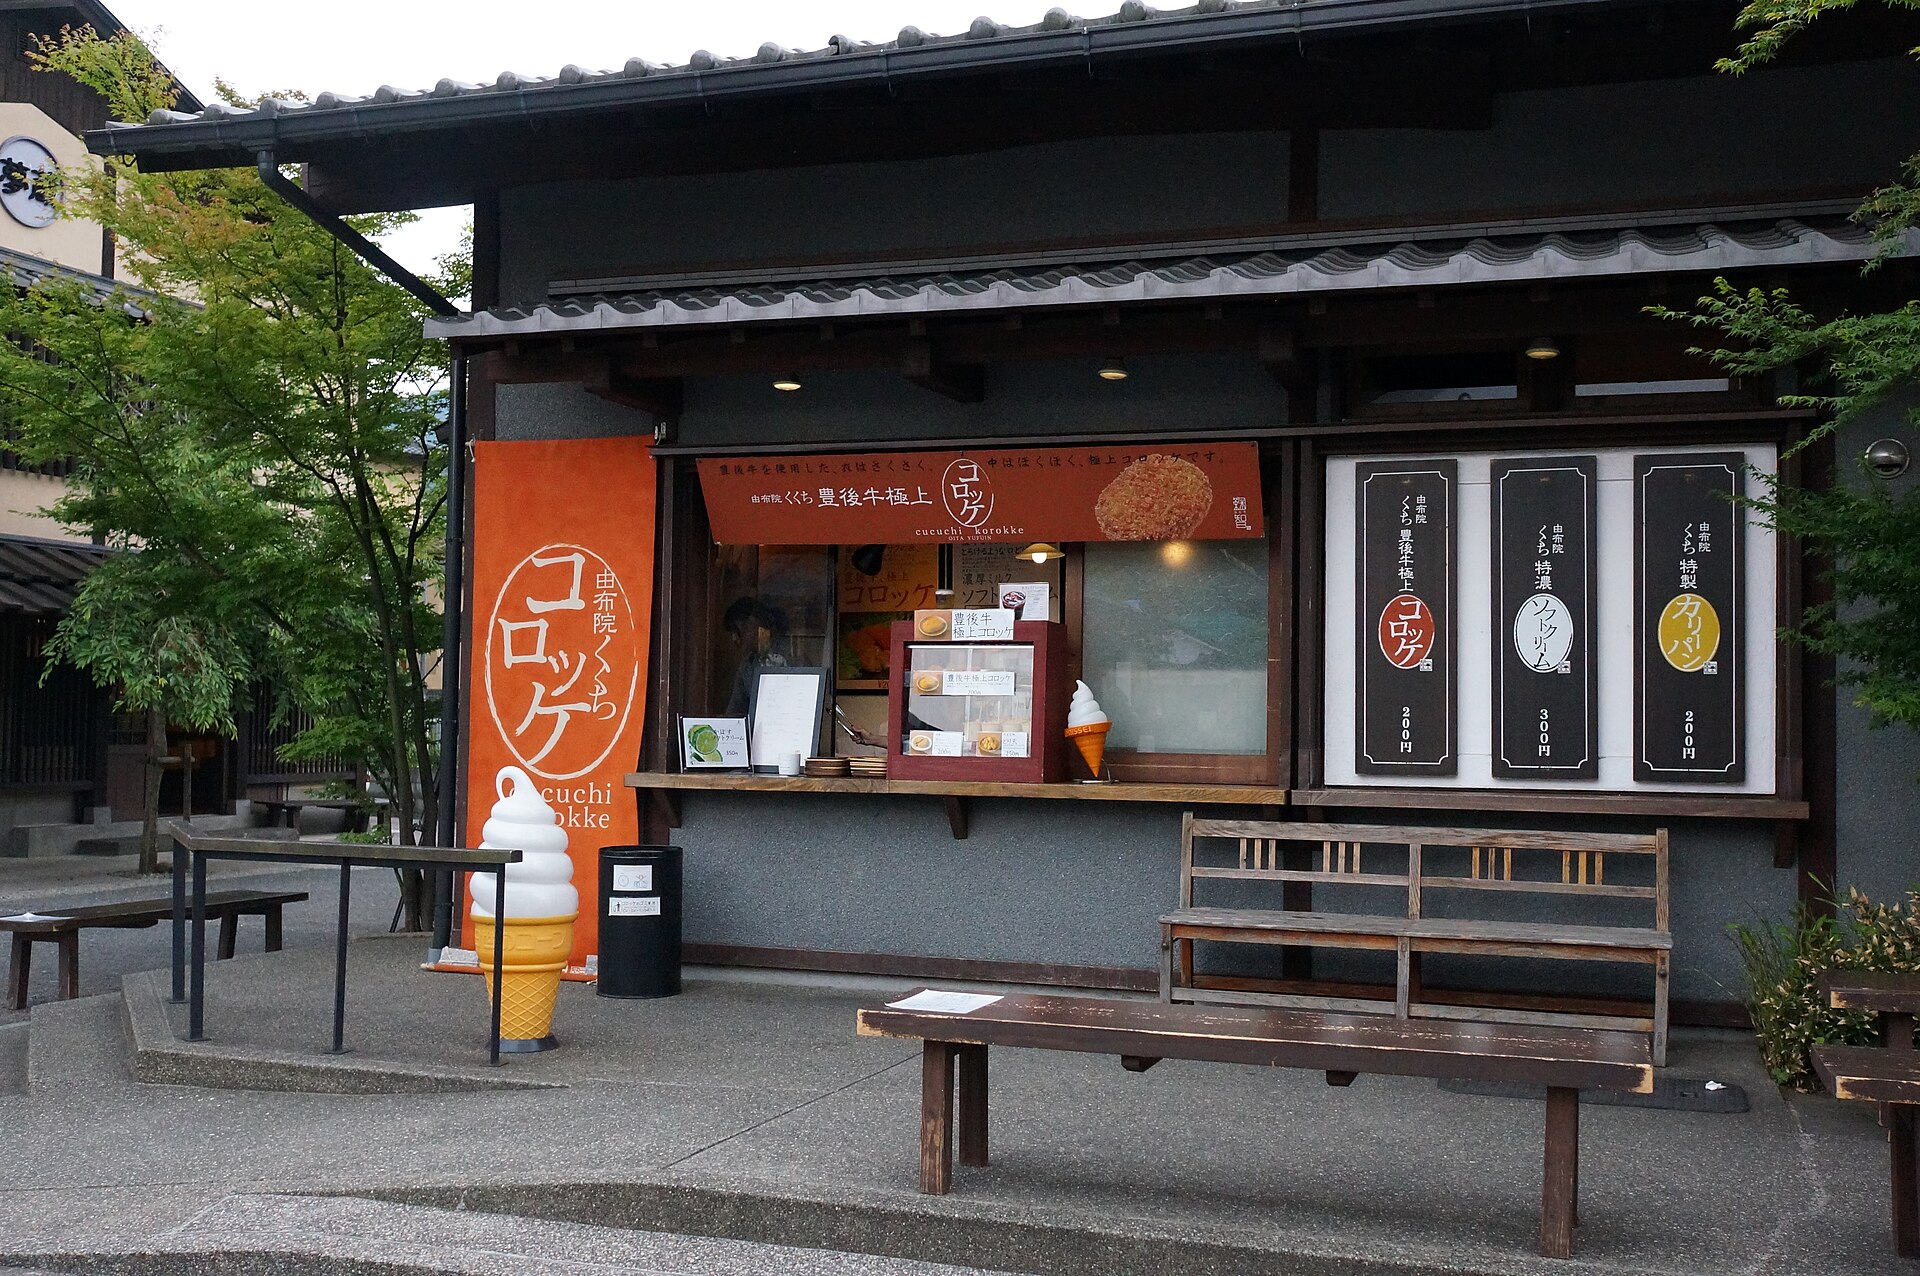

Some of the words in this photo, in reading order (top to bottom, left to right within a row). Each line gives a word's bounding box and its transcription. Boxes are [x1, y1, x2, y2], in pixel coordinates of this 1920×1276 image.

[950, 463, 985, 525] コロッケ
[1415, 494, 1427, 524] 由布院
[915, 526, 962, 536] cucuchi
[975, 525, 1024, 535] korokke
[1552, 523, 1564, 554] 由布院
[1698, 521, 1711, 553] 由布院
[845, 584, 935, 607] コロッケ
[953, 626, 1014, 639] 極上コロッケ
[954, 612, 992, 626] 豊後牛
[1389, 600, 1423, 665] コロッケ
[1532, 599, 1557, 668] ソフトクリーム
[1668, 595, 1701, 669] カリーパン
[498, 553, 592, 765] コロッケ
[1400, 706, 1412, 753] 200円
[1538, 708, 1550, 757] 300円
[1682, 710, 1695, 760] 200円
[541, 781, 612, 805] cuchi
[554, 806, 610, 829] okke
